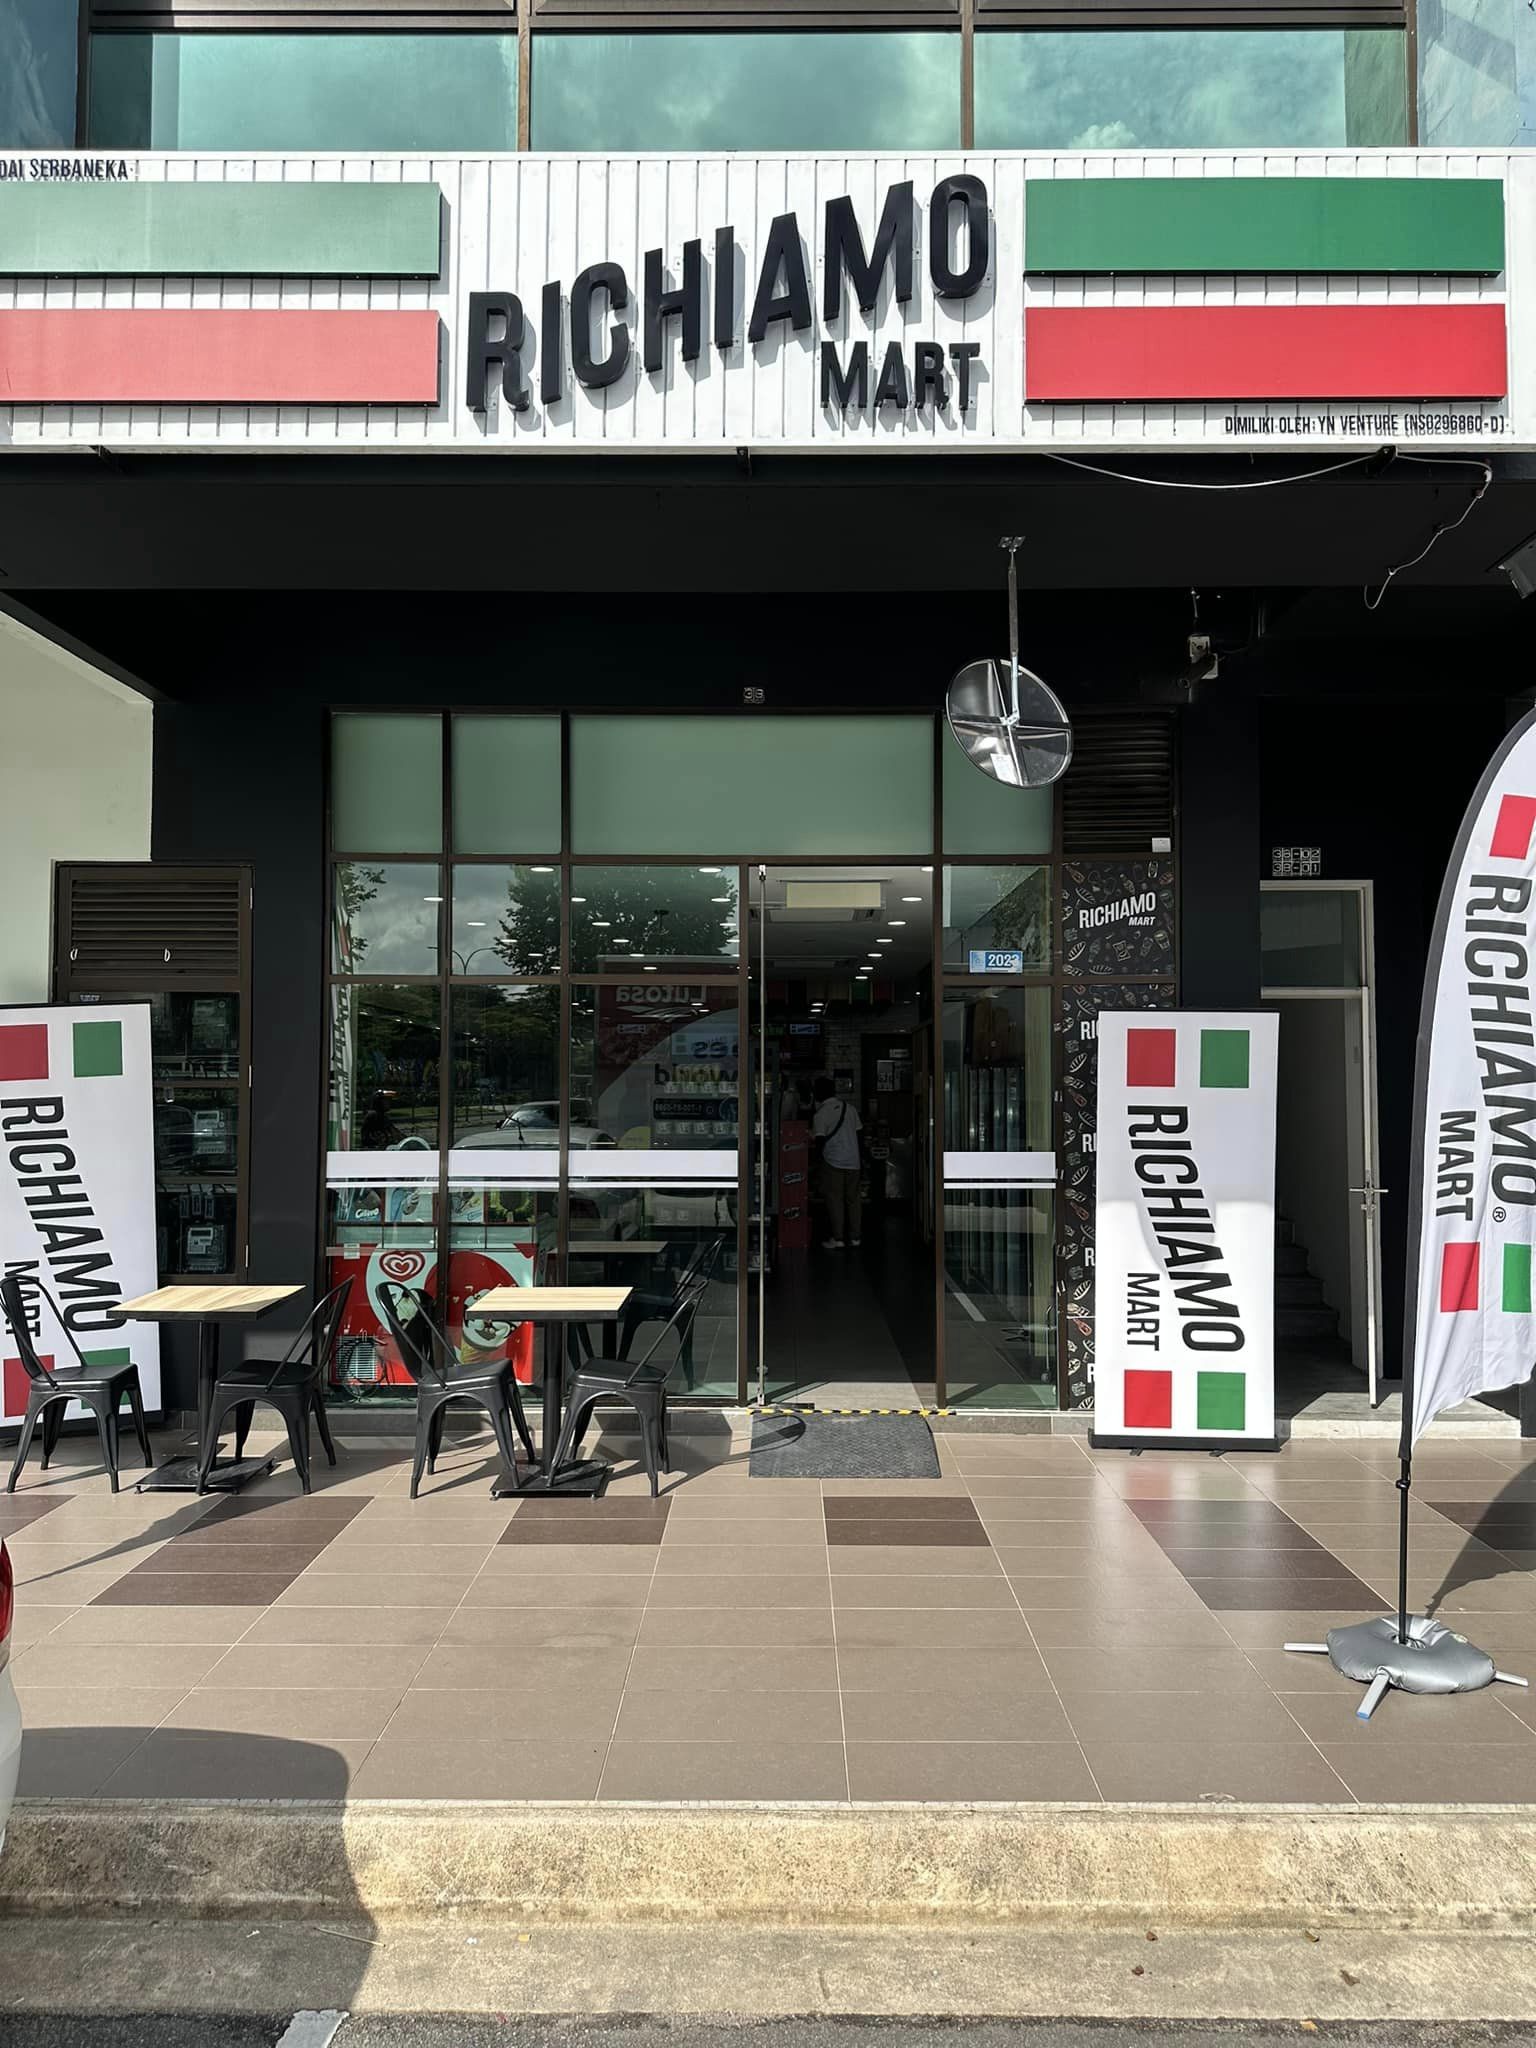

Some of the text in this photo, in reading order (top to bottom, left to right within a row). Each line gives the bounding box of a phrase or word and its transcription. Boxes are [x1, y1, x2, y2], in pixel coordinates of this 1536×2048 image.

[30, 159, 128, 179] SERBANEKA
[466, 173, 988, 412] RICHIAMO
[821, 341, 980, 411] MART
[1225, 416, 1274, 434] DIMILIKI
[1340, 415, 1398, 434] VENTURE
[1079, 892, 1156, 928] RICHIAMO
[1128, 917, 1156, 926] MART
[1465, 874, 1536, 1206] RICHIAMO
[1436, 1110, 1477, 1221] MART
[0, 1096, 127, 1332] RICHIAMO
[1128, 1105, 1245, 1351] RICHIAMO
[1127, 1273, 1160, 1351] MART
